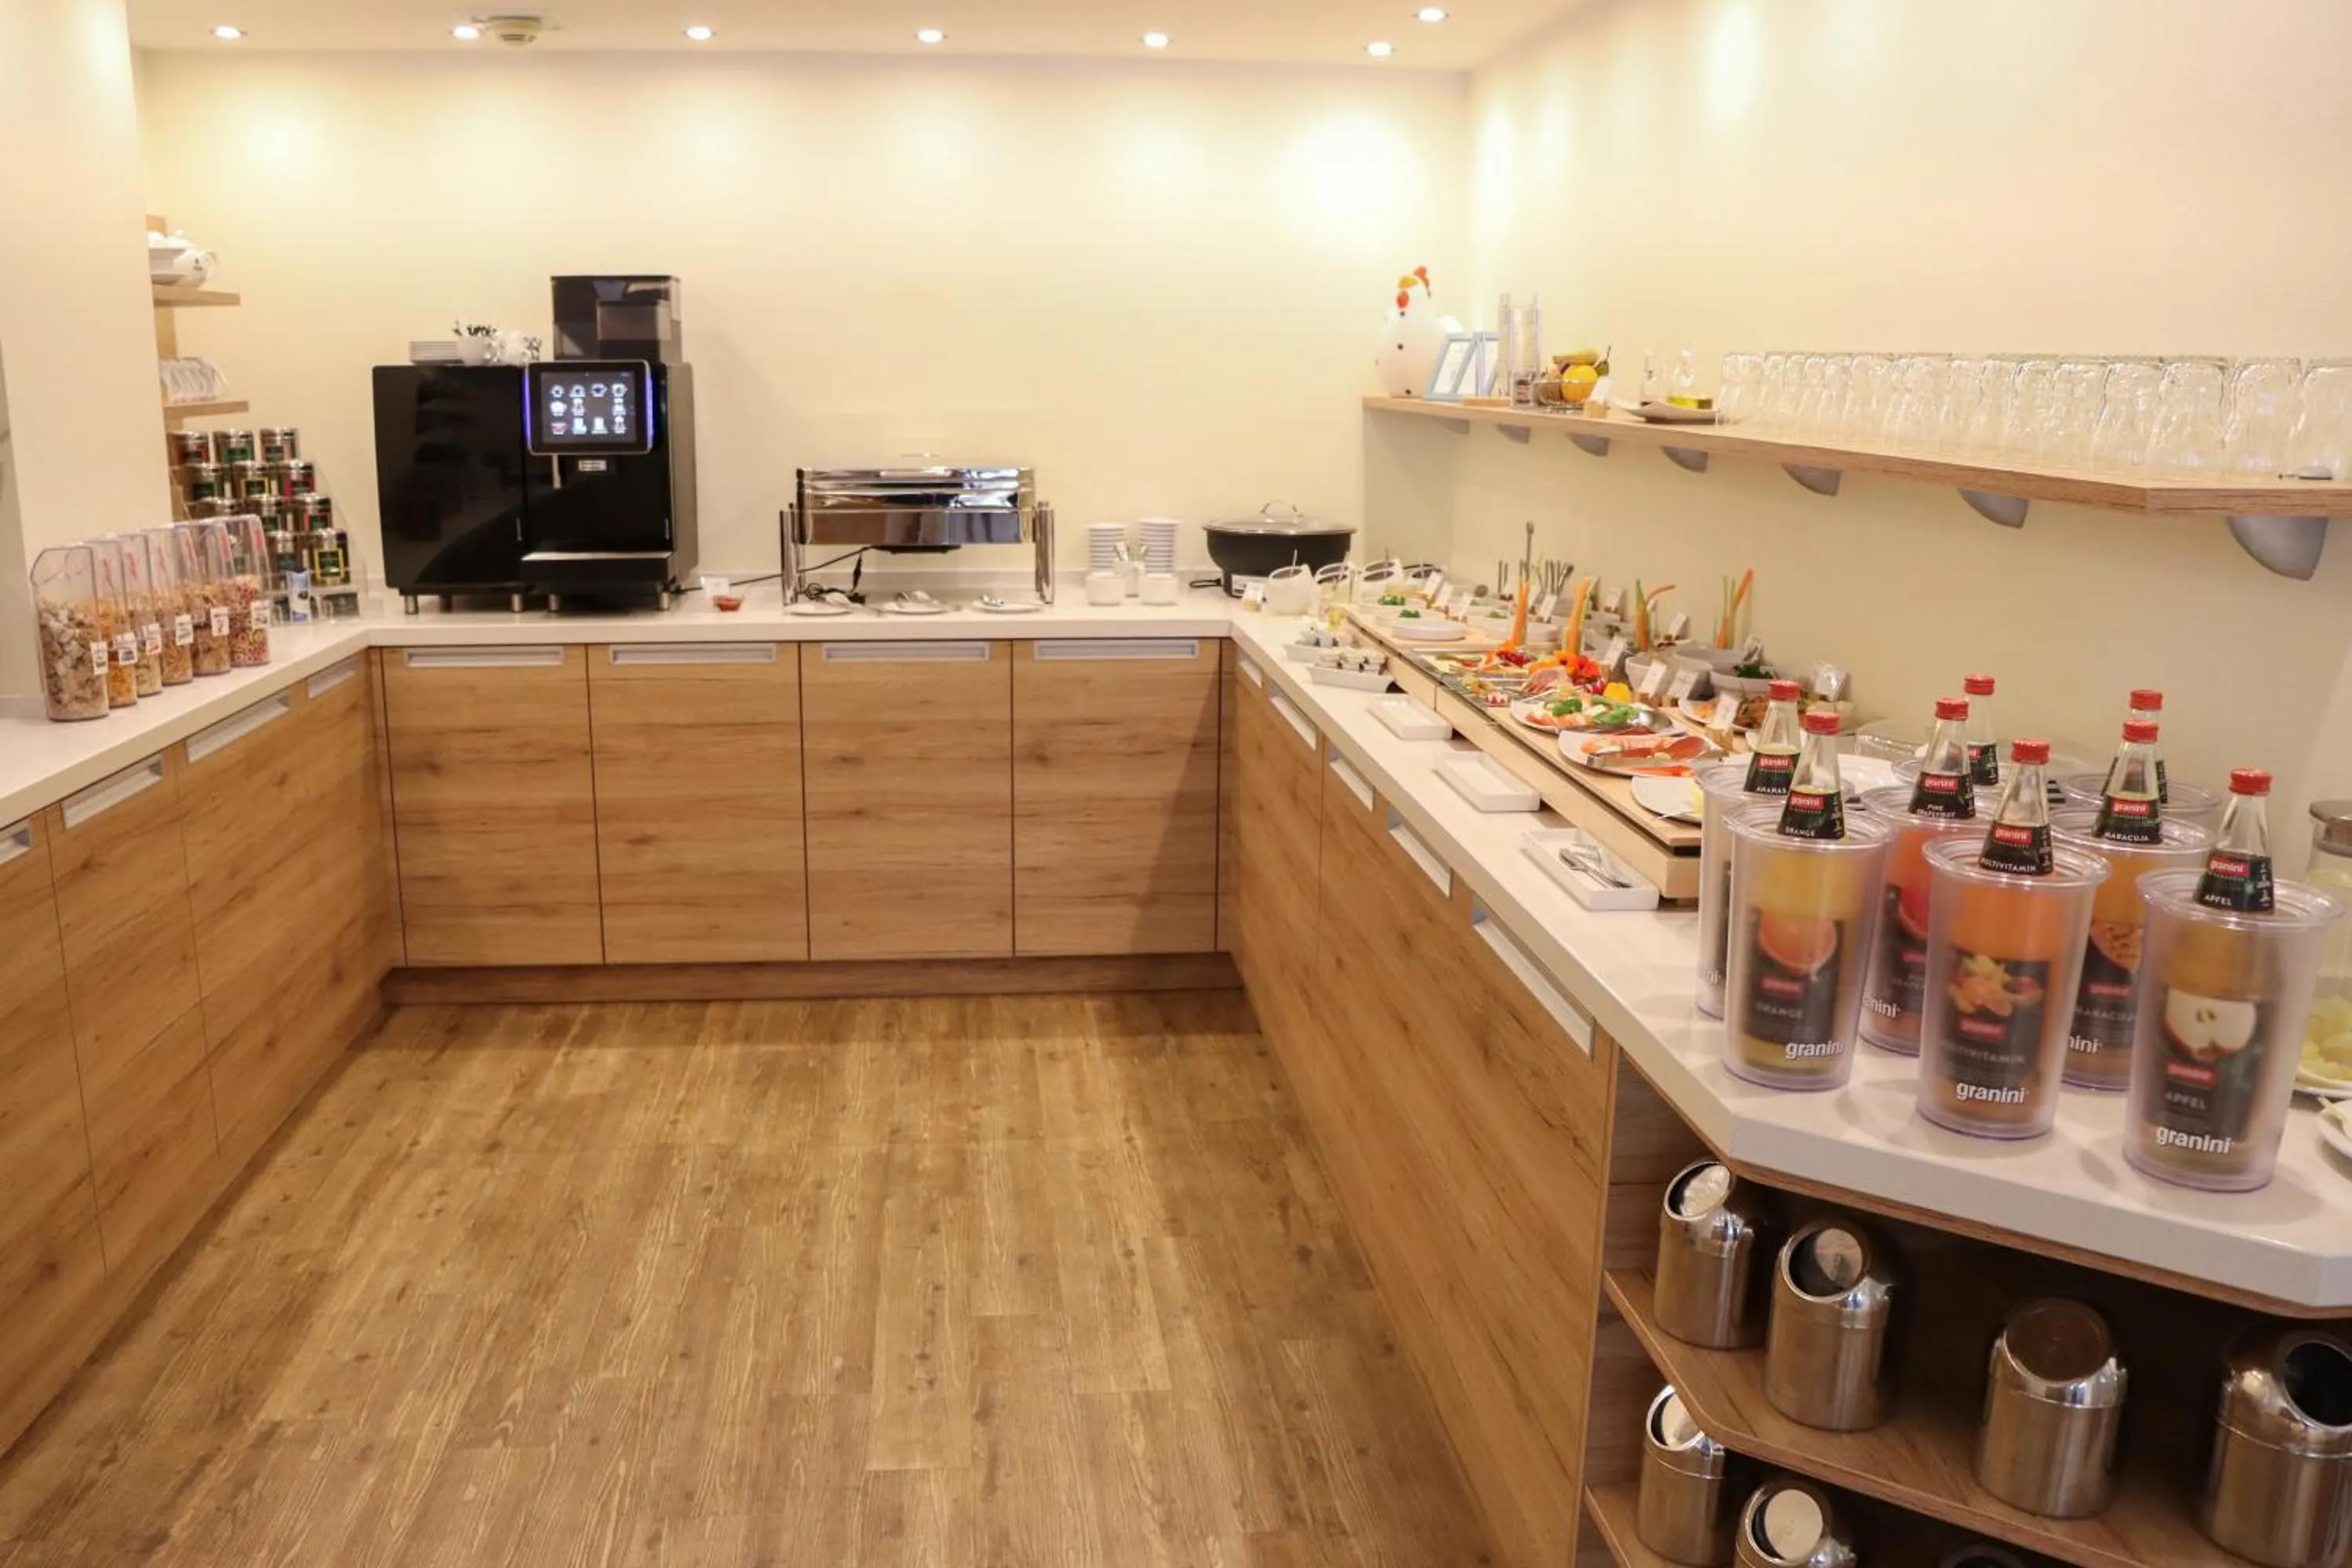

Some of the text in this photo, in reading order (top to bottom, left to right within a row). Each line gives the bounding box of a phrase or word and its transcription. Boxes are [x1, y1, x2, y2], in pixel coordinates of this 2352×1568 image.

[1785, 826, 1817, 837] ORANGE
[2104, 832, 2149, 841] MARACUJA
[2205, 894, 2233, 906] APFEL
[1956, 1083, 2026, 1103] granini
[2157, 1127, 2232, 1154] granini
